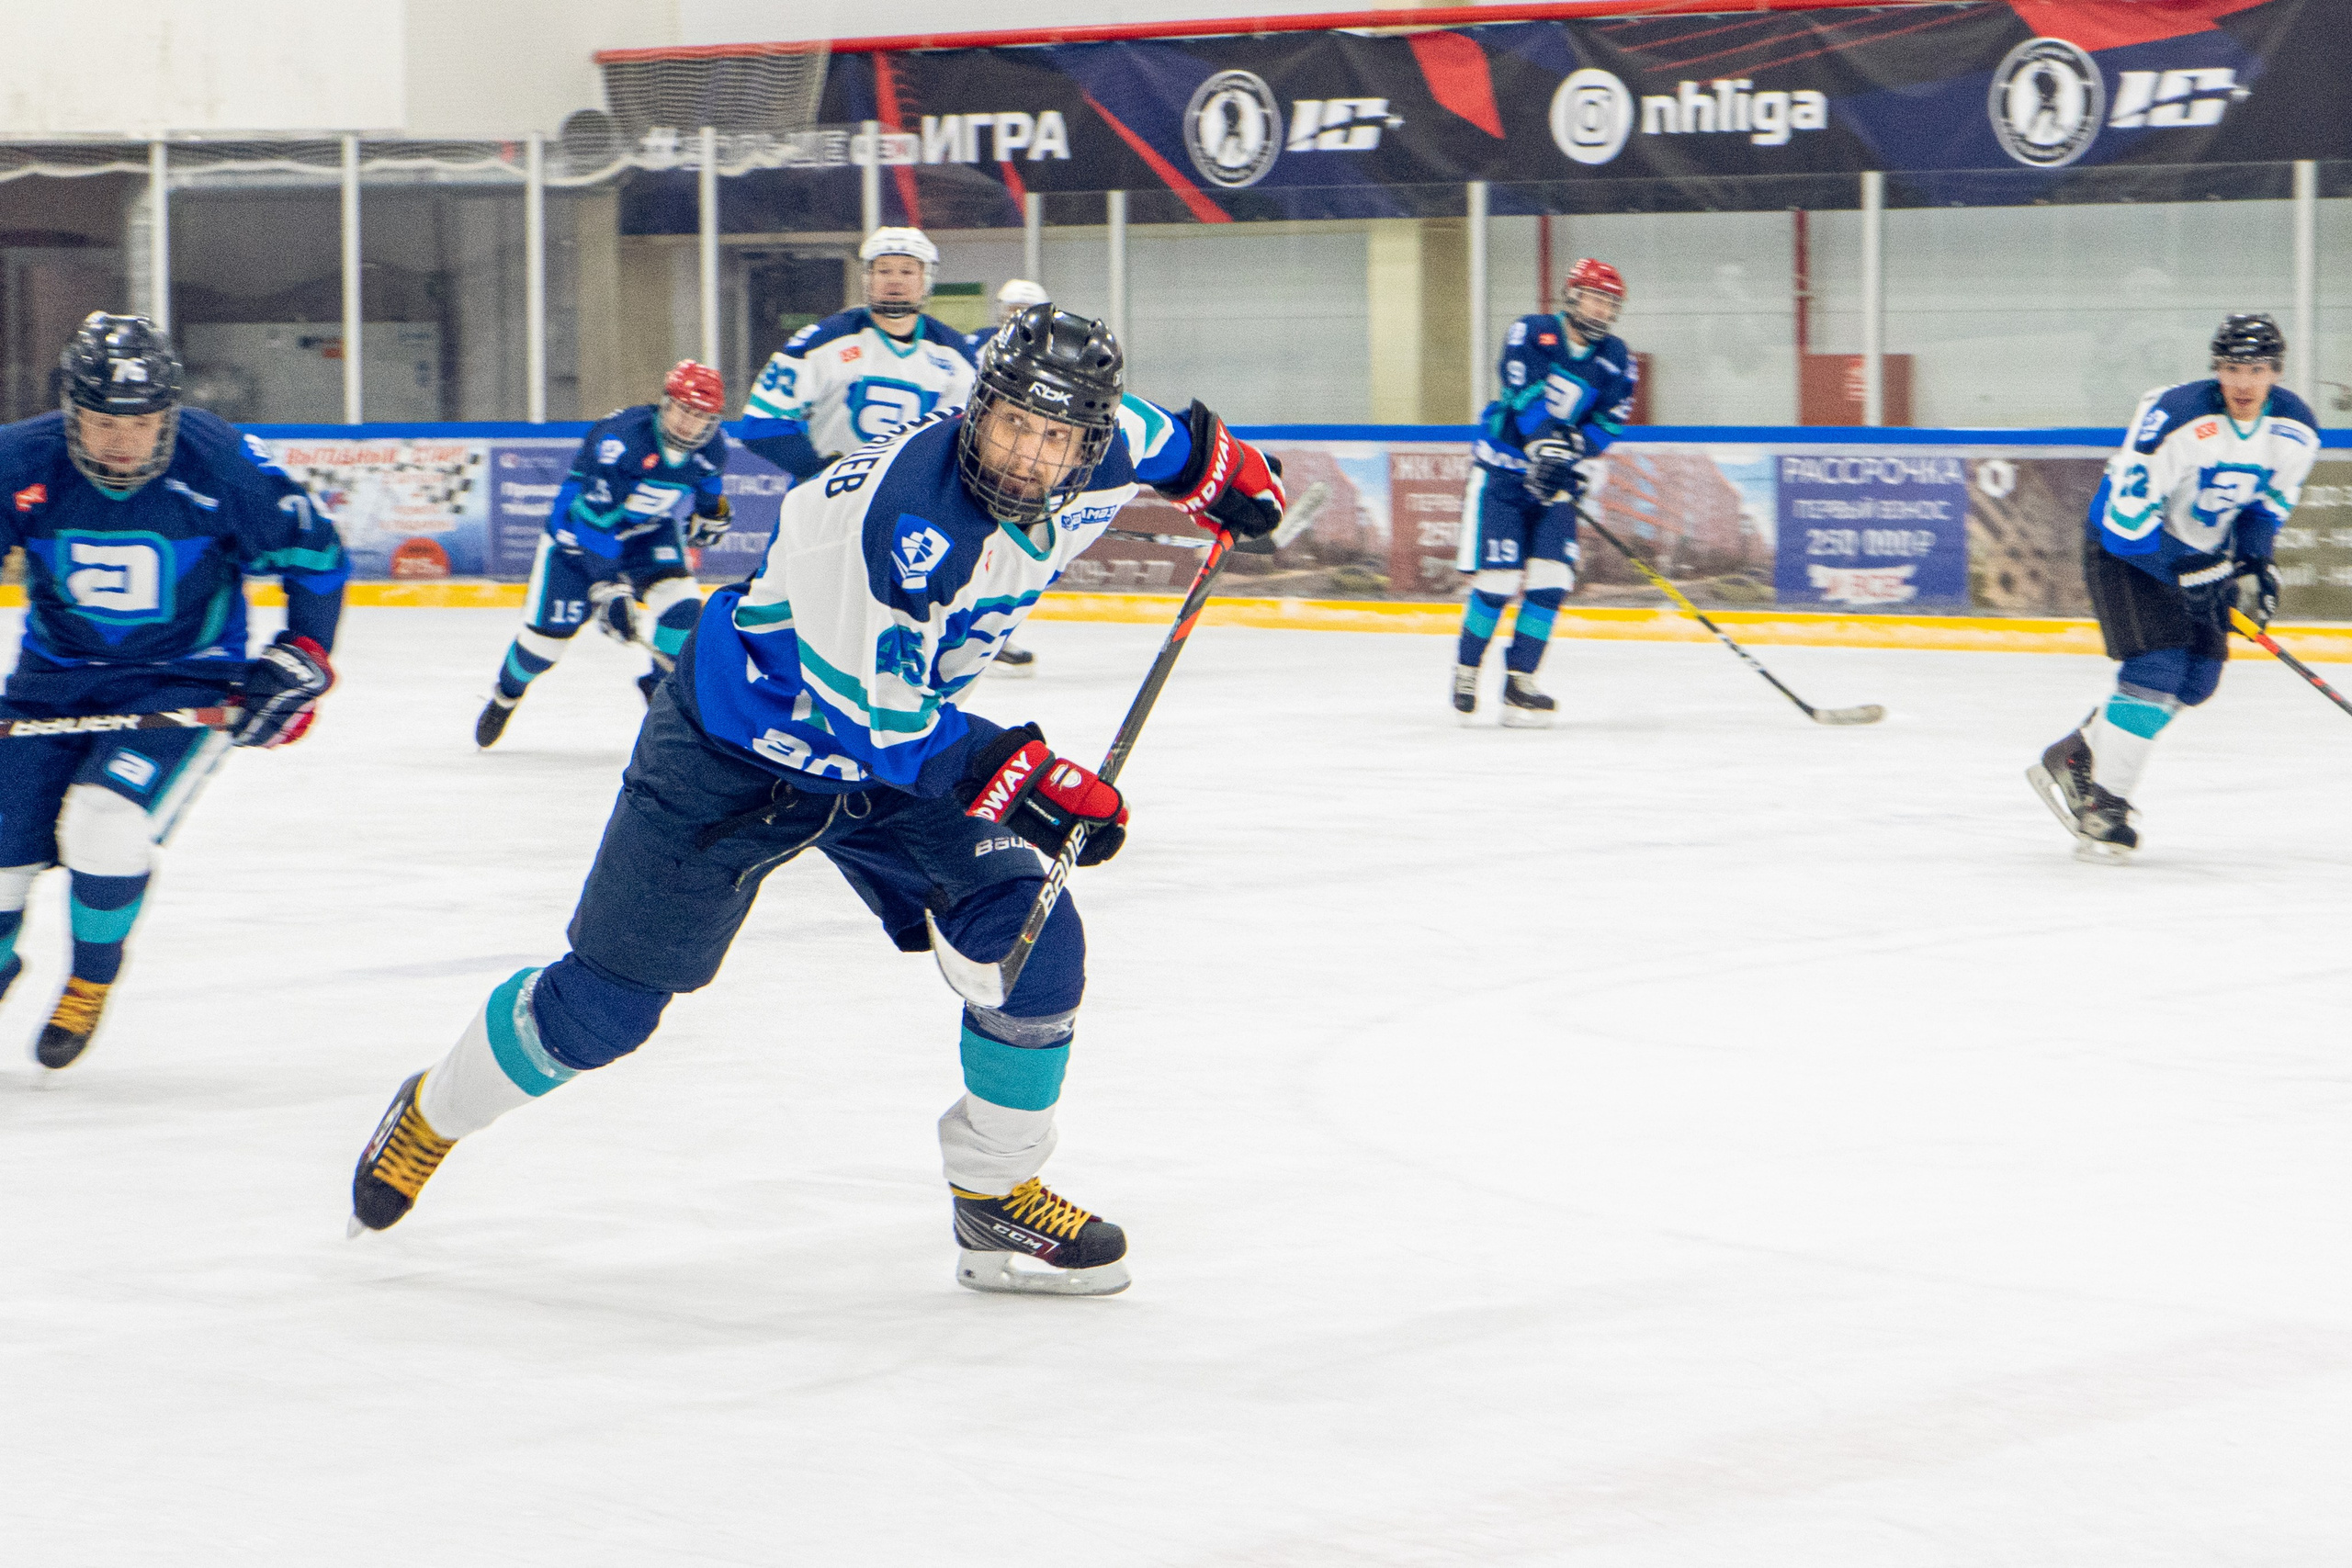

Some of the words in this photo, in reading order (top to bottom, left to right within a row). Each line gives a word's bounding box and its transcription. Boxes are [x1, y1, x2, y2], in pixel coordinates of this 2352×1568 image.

[1641, 79, 1828, 146] nhliga
[921, 110, 1071, 164] ИГРА
[1781, 457, 1964, 485] РАССРОЧКА
[1487, 539, 1521, 563] 19
[550, 599, 585, 623] 15
[992, 1223, 1044, 1250] CCM
